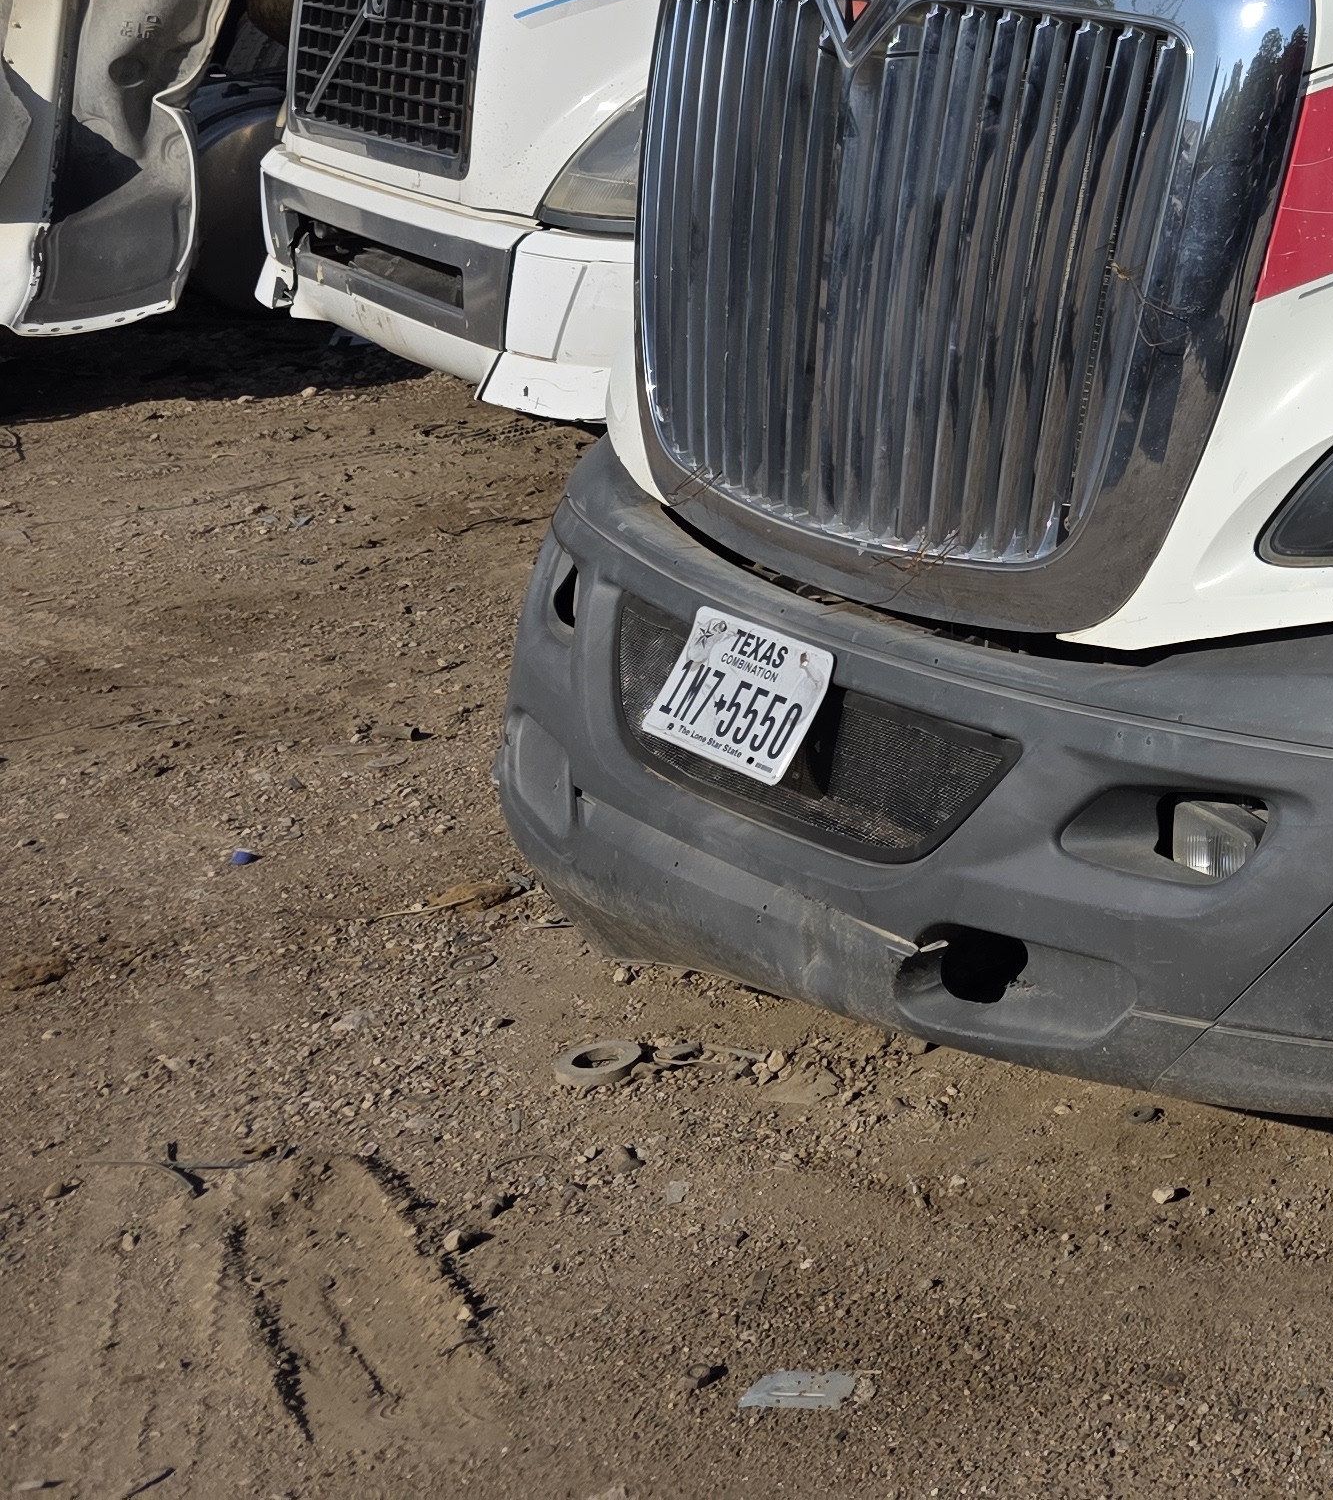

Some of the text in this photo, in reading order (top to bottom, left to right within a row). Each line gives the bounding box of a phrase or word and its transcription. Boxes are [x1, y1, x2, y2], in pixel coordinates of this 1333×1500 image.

[730, 628, 789, 669] TEXAS
[720, 652, 779, 683] COMBINATION
[678, 724, 743, 759] The Lone Star State
